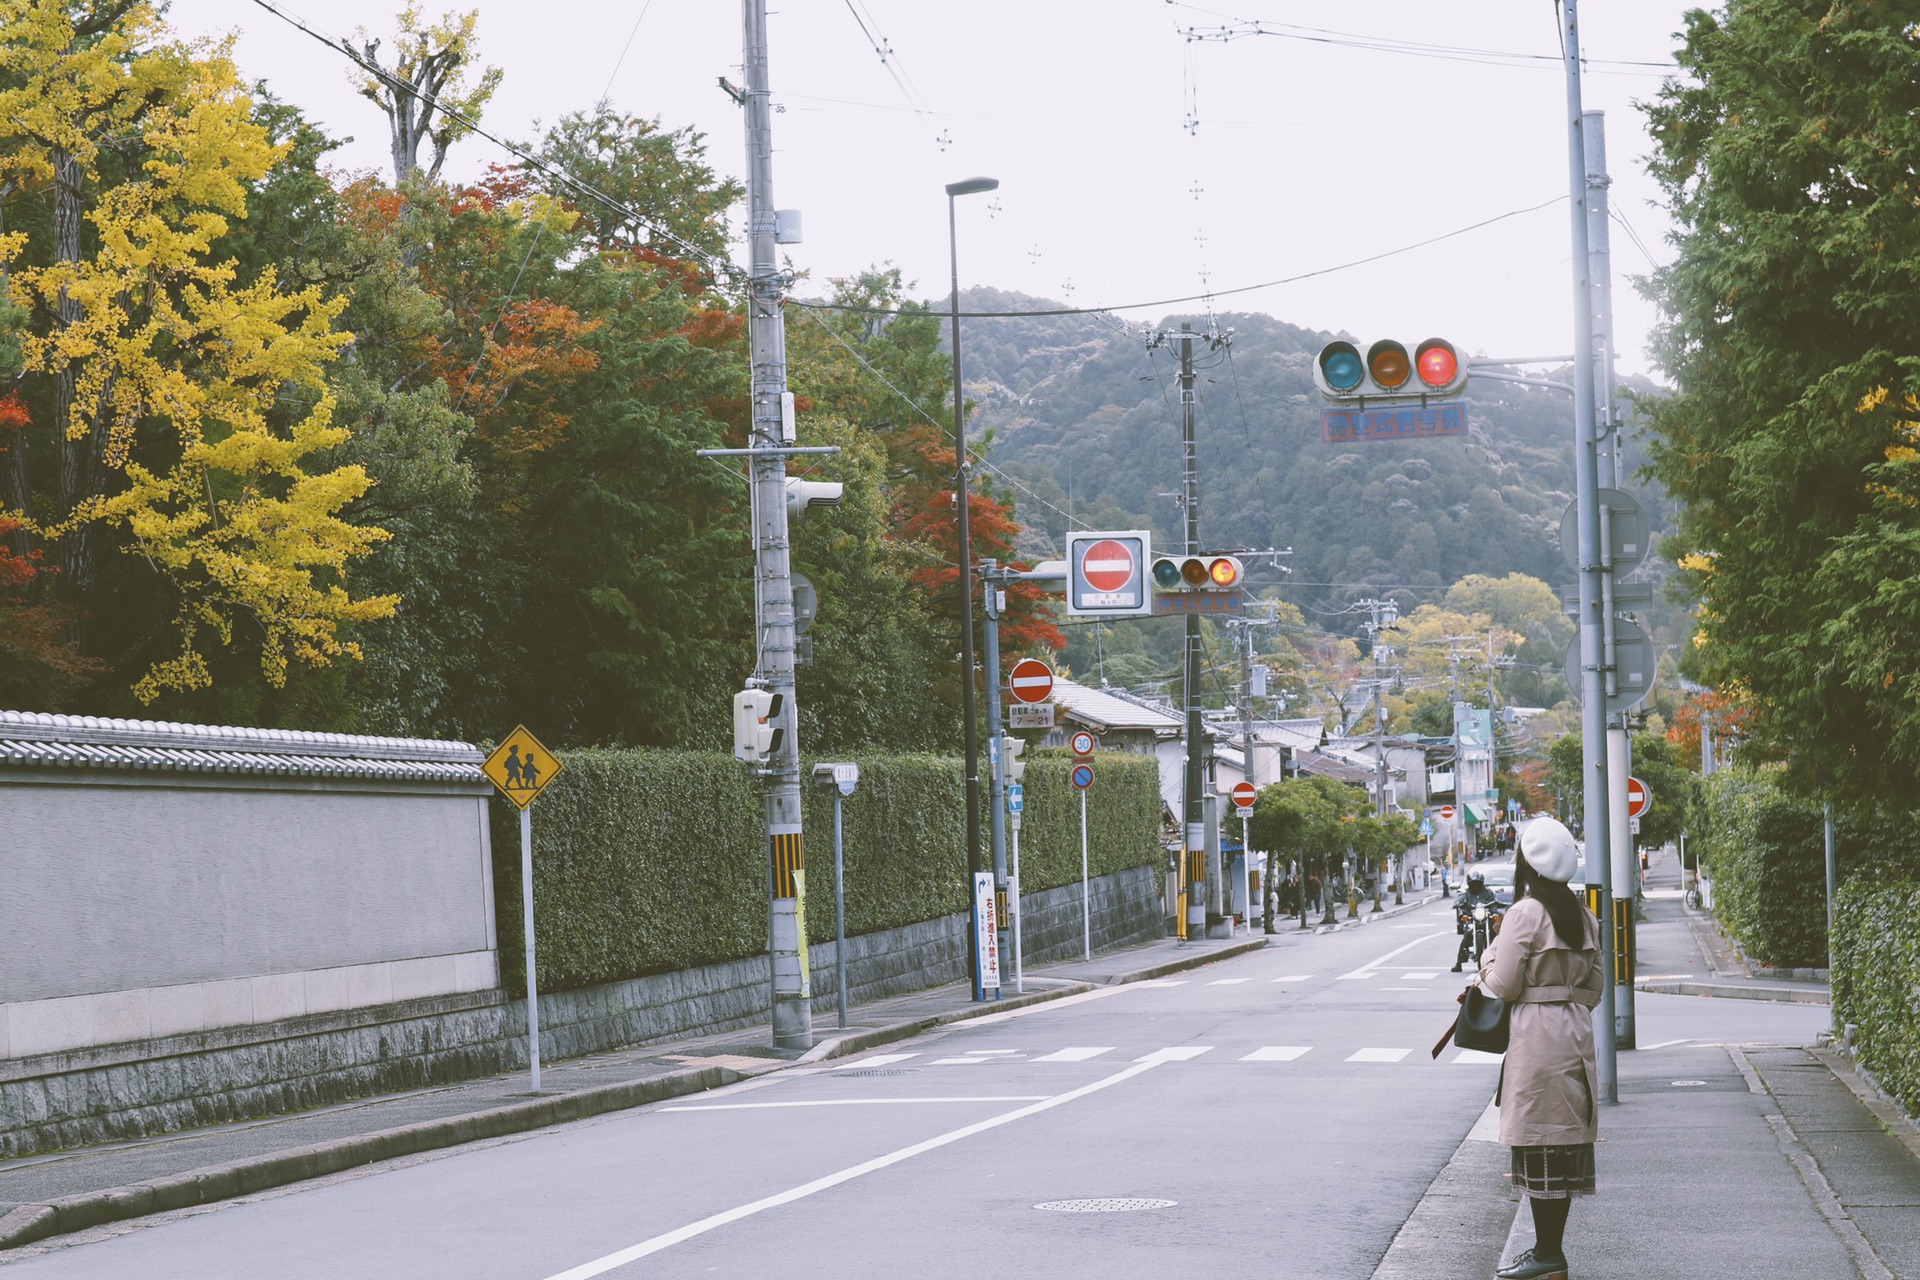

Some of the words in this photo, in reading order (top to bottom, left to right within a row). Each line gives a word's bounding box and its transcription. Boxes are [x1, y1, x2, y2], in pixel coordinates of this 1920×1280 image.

[1076, 738, 1090, 750] 30
[986, 897, 997, 974] 右折進入禁止
